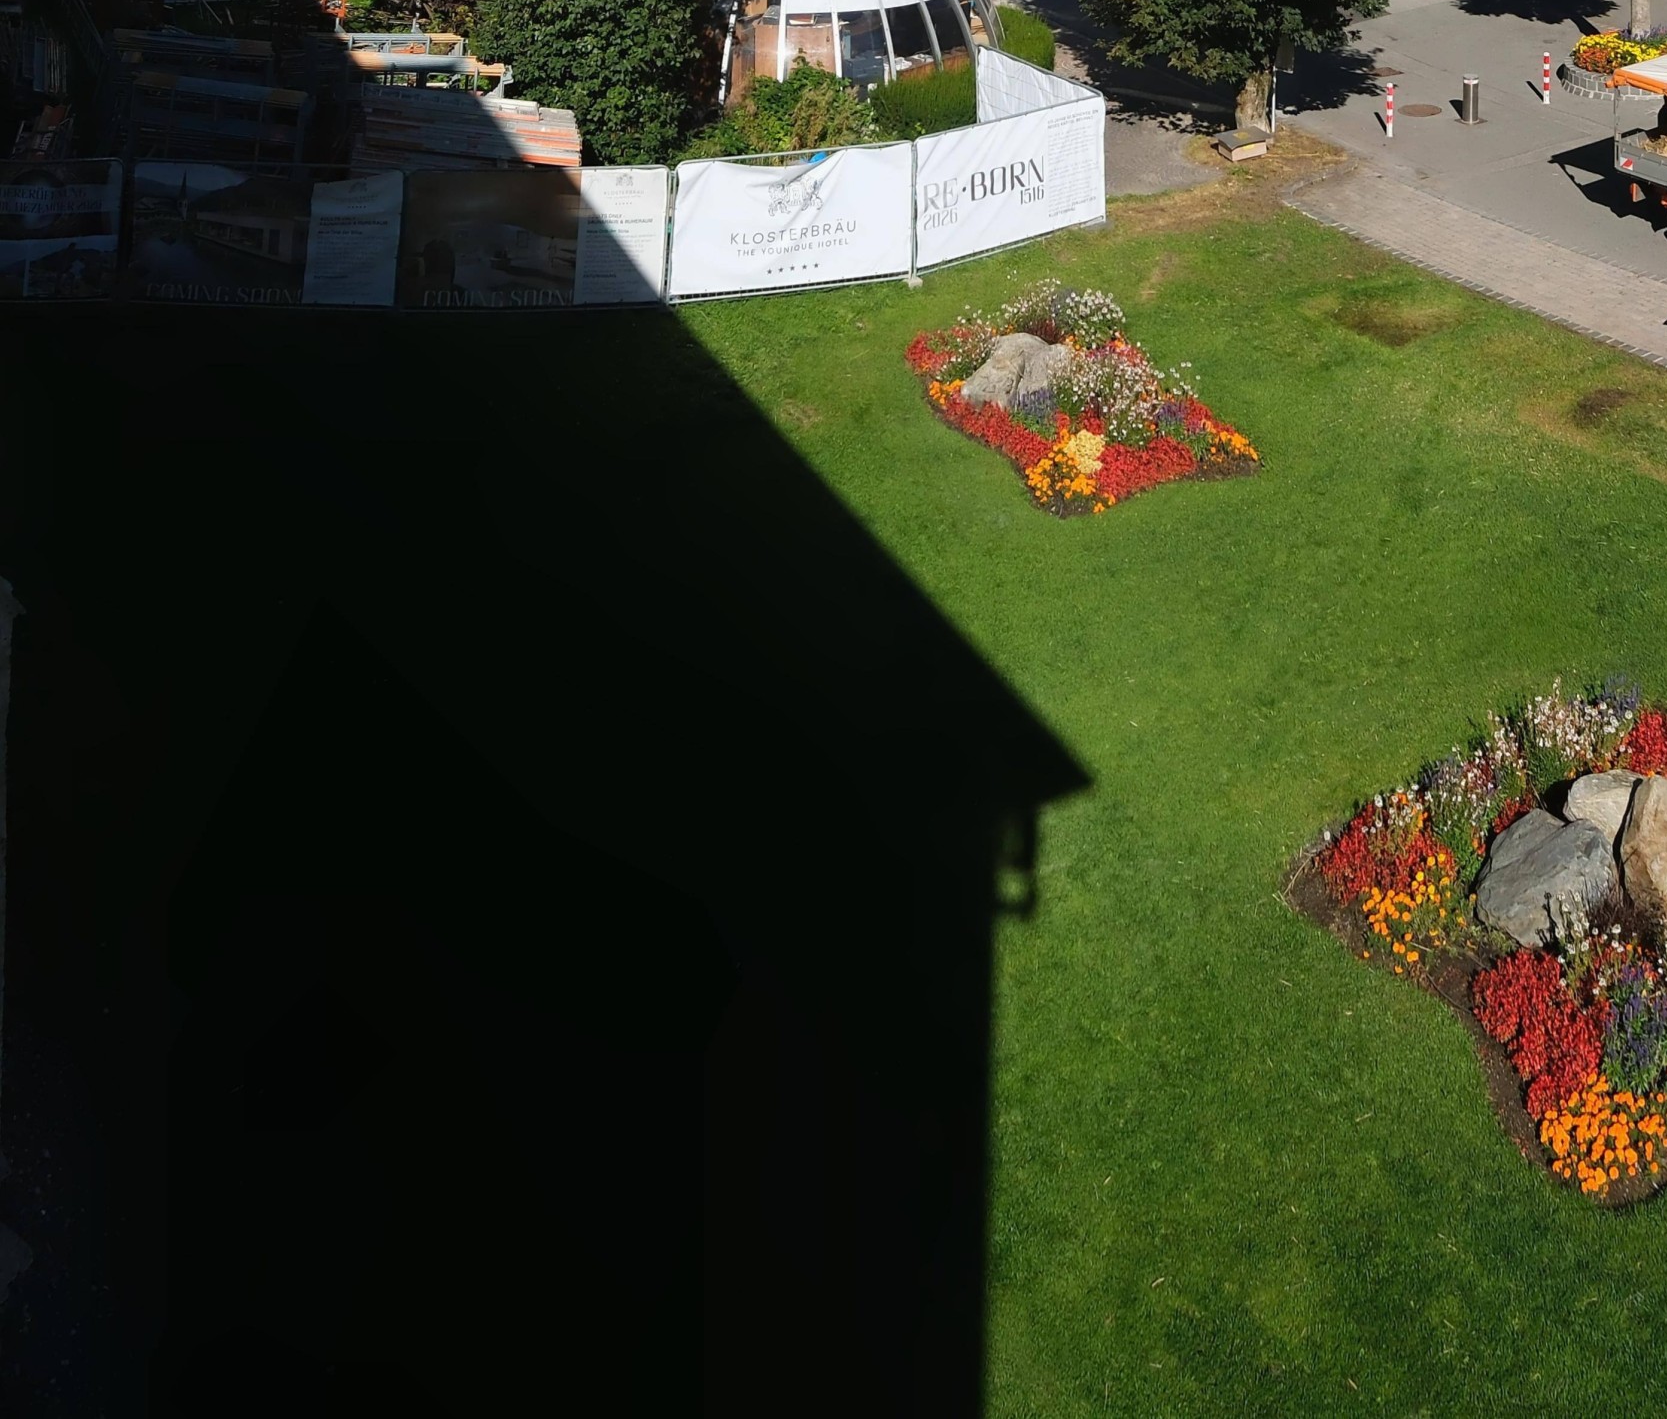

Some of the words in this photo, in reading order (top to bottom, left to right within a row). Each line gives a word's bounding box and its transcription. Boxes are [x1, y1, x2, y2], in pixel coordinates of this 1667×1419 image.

[1019, 184, 1045, 206] 1516
[923, 207, 958, 231] 2026
[730, 218, 857, 245] KLOSTERBRÄU
[146, 283, 229, 304] COMING
[423, 289, 504, 307] COMING
